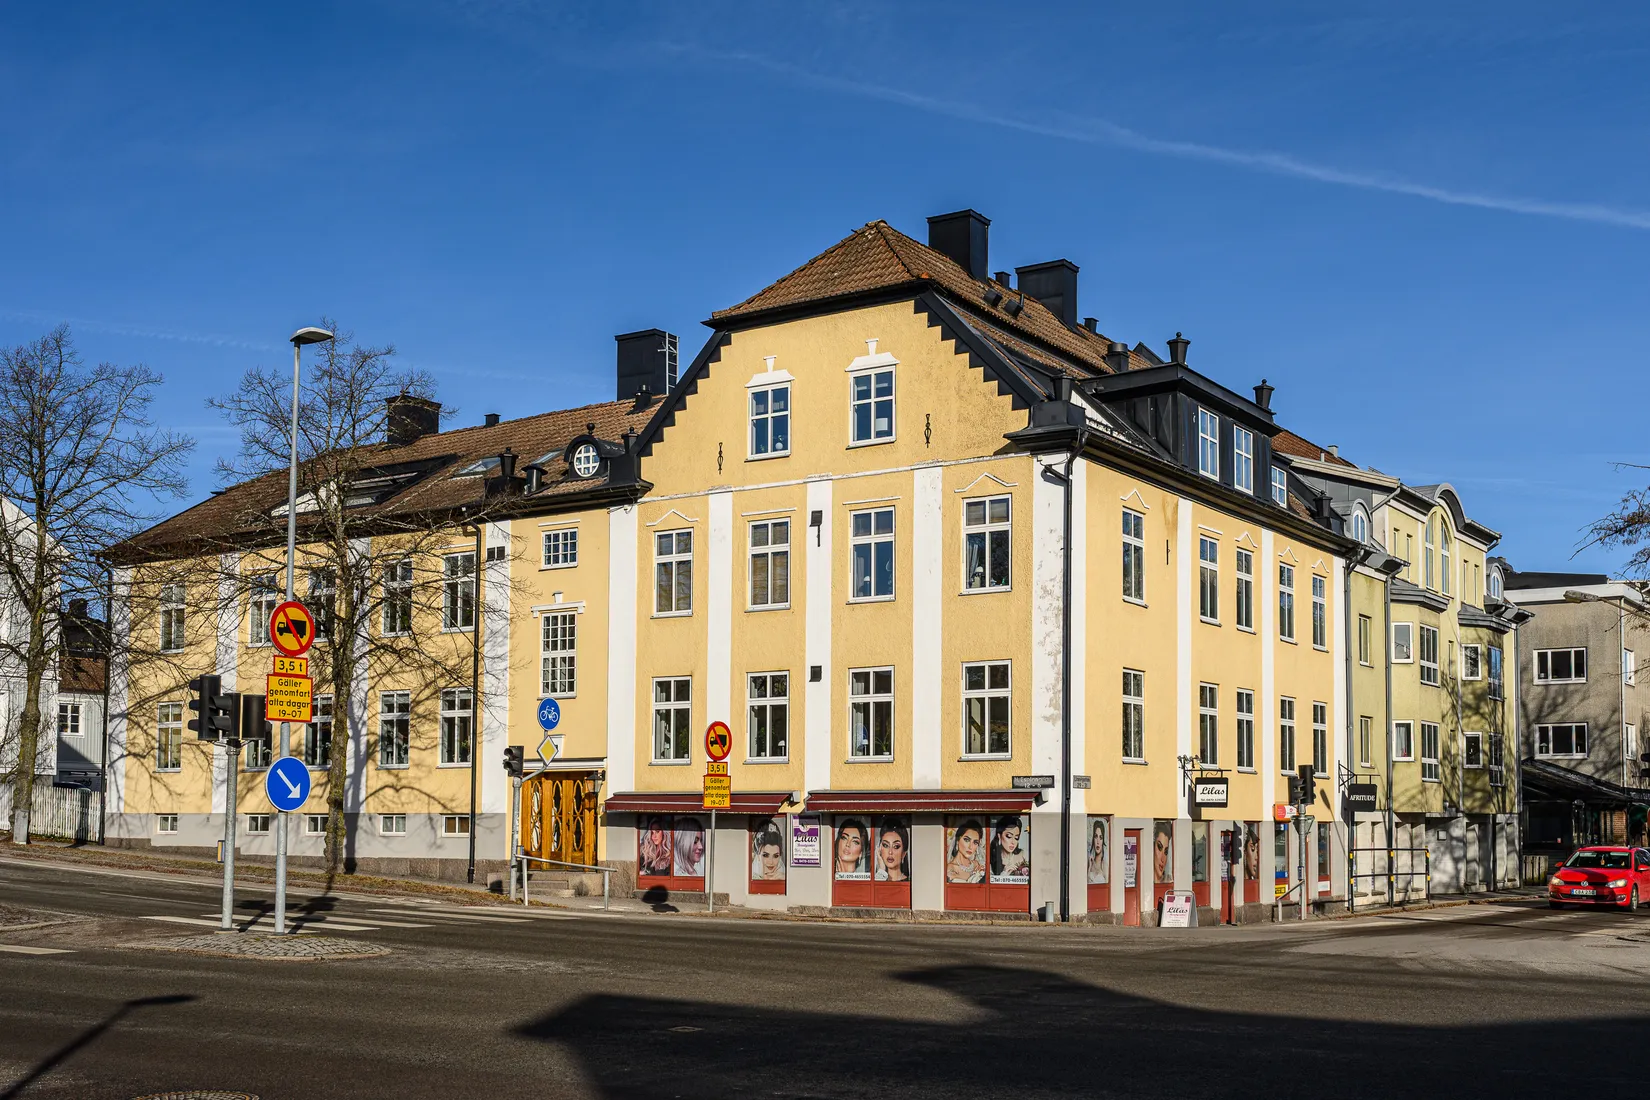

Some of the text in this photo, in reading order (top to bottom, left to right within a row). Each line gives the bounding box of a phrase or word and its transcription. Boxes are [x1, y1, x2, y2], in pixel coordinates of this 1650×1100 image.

[278, 660, 302, 672] 3,5 t
[278, 678, 302, 688] Gäller
[268, 689, 310, 698] genomfart
[268, 698, 310, 710] alla dagar
[278, 710, 302, 718] 19-07
[710, 764, 720, 774] 3,5
[1200, 786, 1225, 794] Lilas
[795, 832, 817, 842] Lilas
